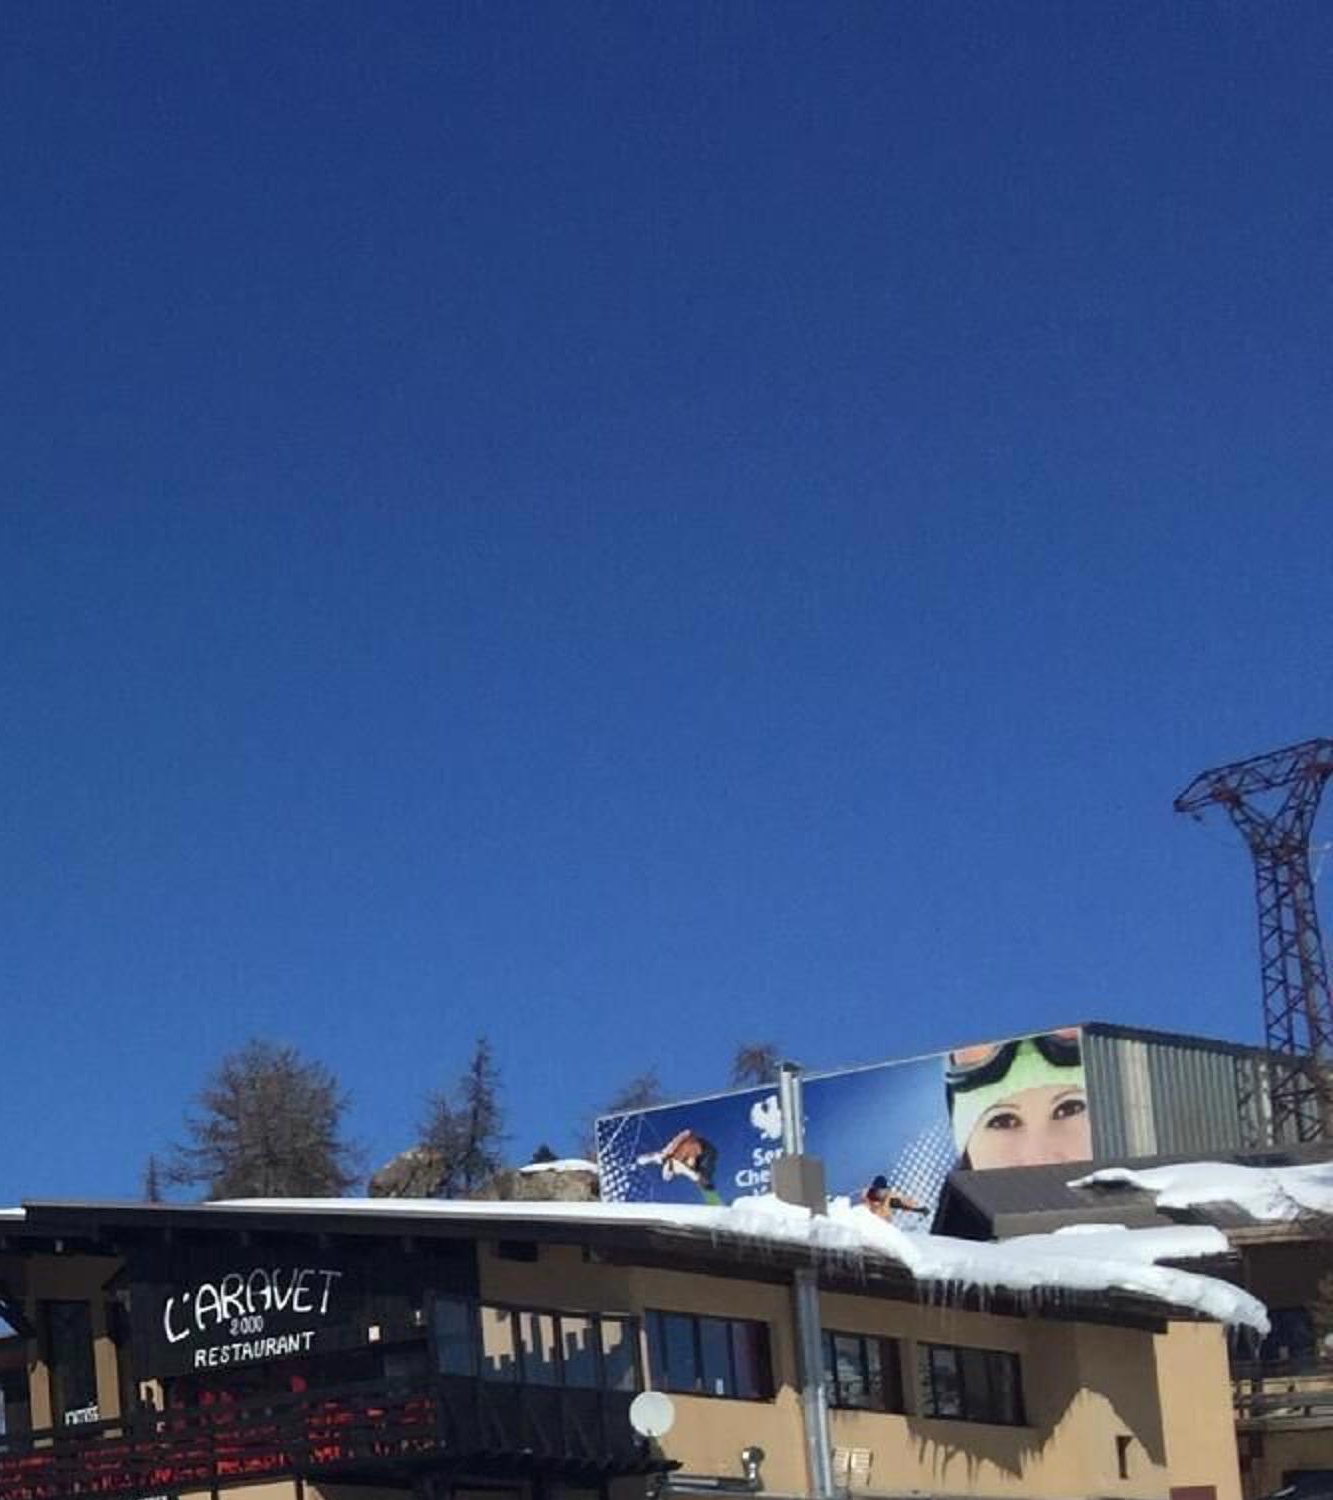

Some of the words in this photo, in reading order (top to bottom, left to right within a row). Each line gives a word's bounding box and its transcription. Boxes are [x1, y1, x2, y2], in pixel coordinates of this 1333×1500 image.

[163, 1267, 342, 1343] L'ARAVET
[229, 1315, 264, 1335] 2000
[194, 1331, 316, 1369] RESTAURANT
